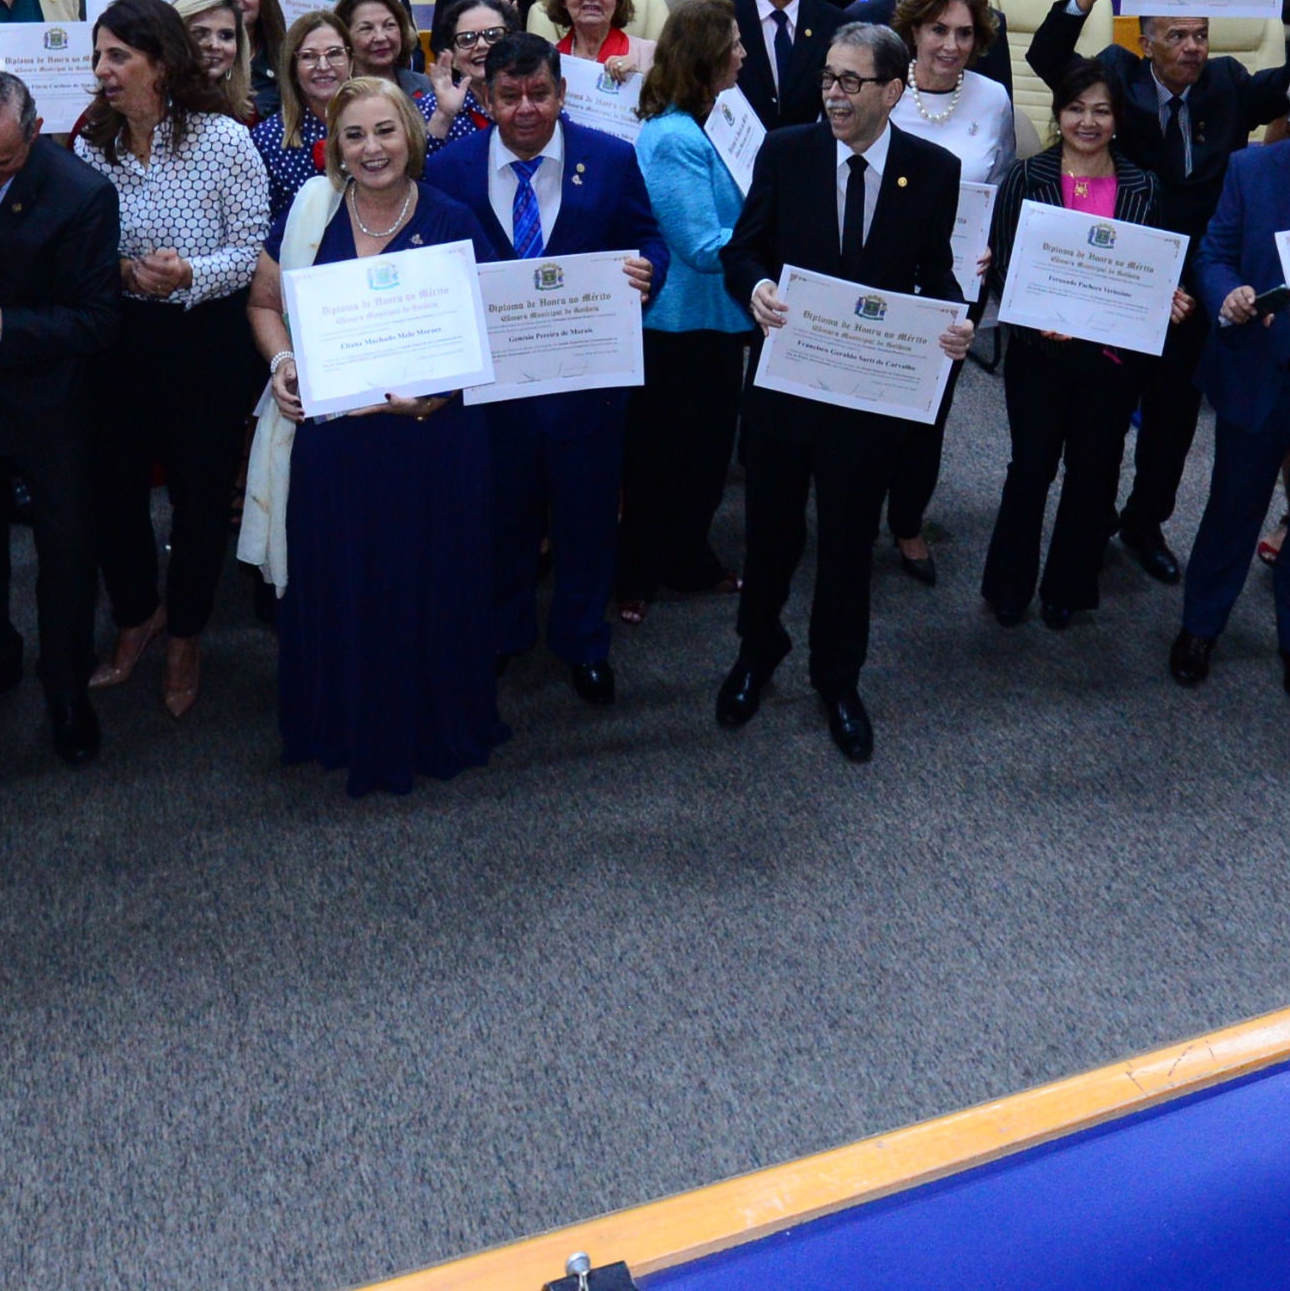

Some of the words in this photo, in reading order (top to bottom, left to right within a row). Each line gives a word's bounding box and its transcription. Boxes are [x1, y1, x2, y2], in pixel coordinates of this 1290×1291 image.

[4, 56, 34, 64] Diploma
[1041, 241, 1075, 257] Diploma
[1076, 249, 1085, 258] de
[1087, 252, 1113, 264] Honra
[1114, 259, 1125, 267] ao
[1126, 260, 1155, 274] Mérito
[1047, 274, 1077, 286] Fernando
[1077, 281, 1102, 291] Pacheco
[321, 301, 359, 316] Diploma
[361, 299, 370, 309] de
[374, 293, 402, 306] Honra
[405, 292, 415, 301] ao
[418, 285, 449, 299] Mérito
[487, 299, 523, 313] Diploma
[526, 299, 535, 308] de
[538, 295, 565, 307] Honra
[581, 290, 610, 302] Mérito
[529, 309, 562, 319] Municipal
[340, 339, 362, 349] Eliana
[364, 333, 395, 345] Machado
[397, 330, 415, 339] Melo
[416, 325, 441, 336] Moraes
[535, 330, 559, 339] Pereira
[570, 327, 592, 335] Morais
[802, 309, 840, 326] Diploma
[840, 320, 851, 329] de
[853, 323, 882, 336] Honra
[883, 330, 895, 338] ao
[896, 331, 928, 346] Mérito
[840, 331, 875, 344] Municipal
[796, 340, 830, 352] Francisco
[829, 348, 858, 360] Geraldo
[885, 359, 916, 372] Carvalho
